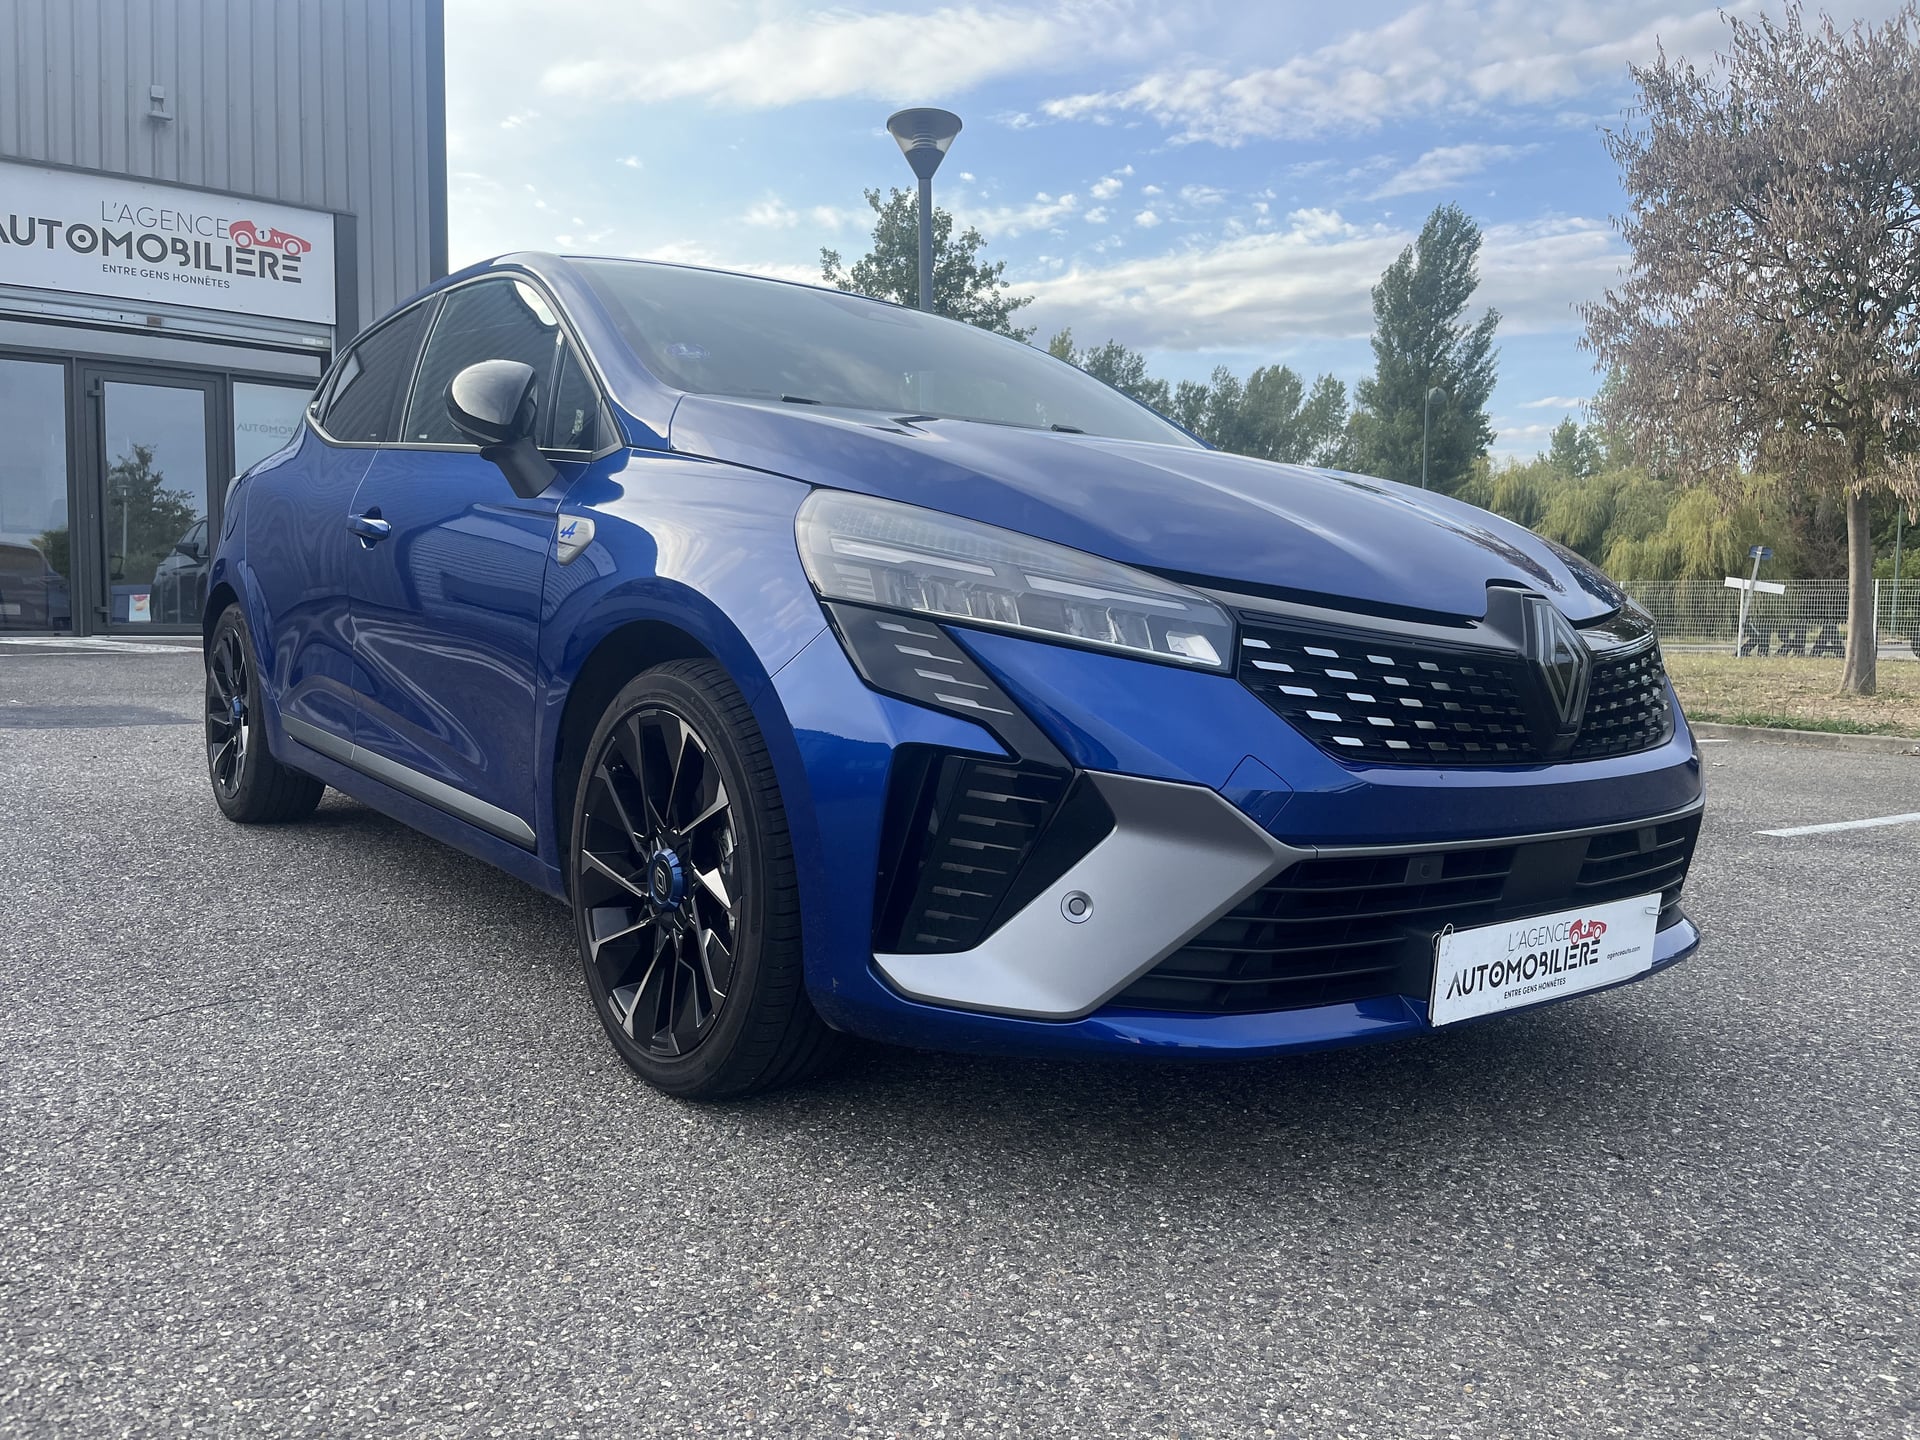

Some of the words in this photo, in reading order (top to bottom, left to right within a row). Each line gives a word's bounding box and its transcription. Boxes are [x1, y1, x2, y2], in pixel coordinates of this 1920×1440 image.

[101, 200, 230, 240] L'AGENCE
[102, 263, 138, 277] ENTRE
[140, 268, 170, 281] GENS
[172, 274, 231, 289] HONNÊTES
[1508, 921, 1571, 952] L'AGENCE
[1503, 987, 1522, 1000] ENTRE
[1522, 983, 1538, 995] GENS
[1538, 977, 1567, 991] HONNÊTES
